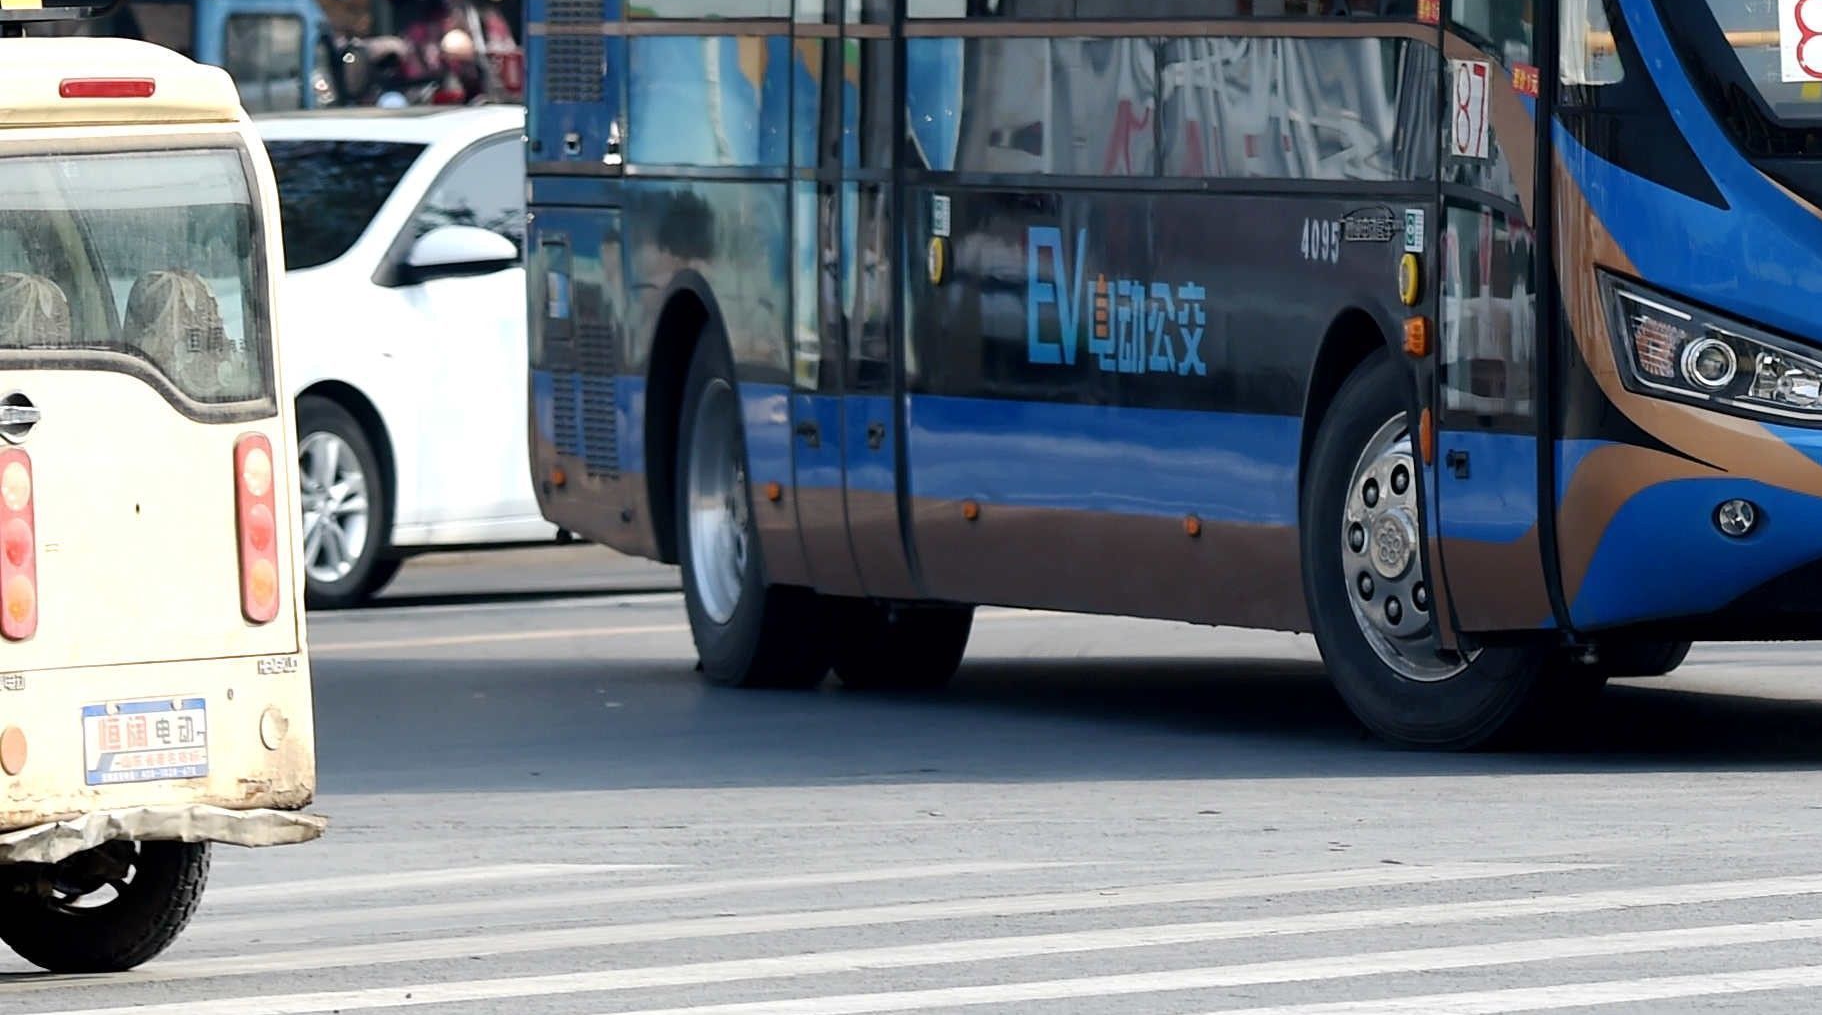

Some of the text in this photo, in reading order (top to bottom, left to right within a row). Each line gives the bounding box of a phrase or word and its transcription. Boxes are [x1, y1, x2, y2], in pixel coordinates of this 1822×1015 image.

[1456, 63, 1487, 157] 87
[1301, 217, 1341, 264] 4095
[1028, 226, 1207, 376] EV 电动公交
